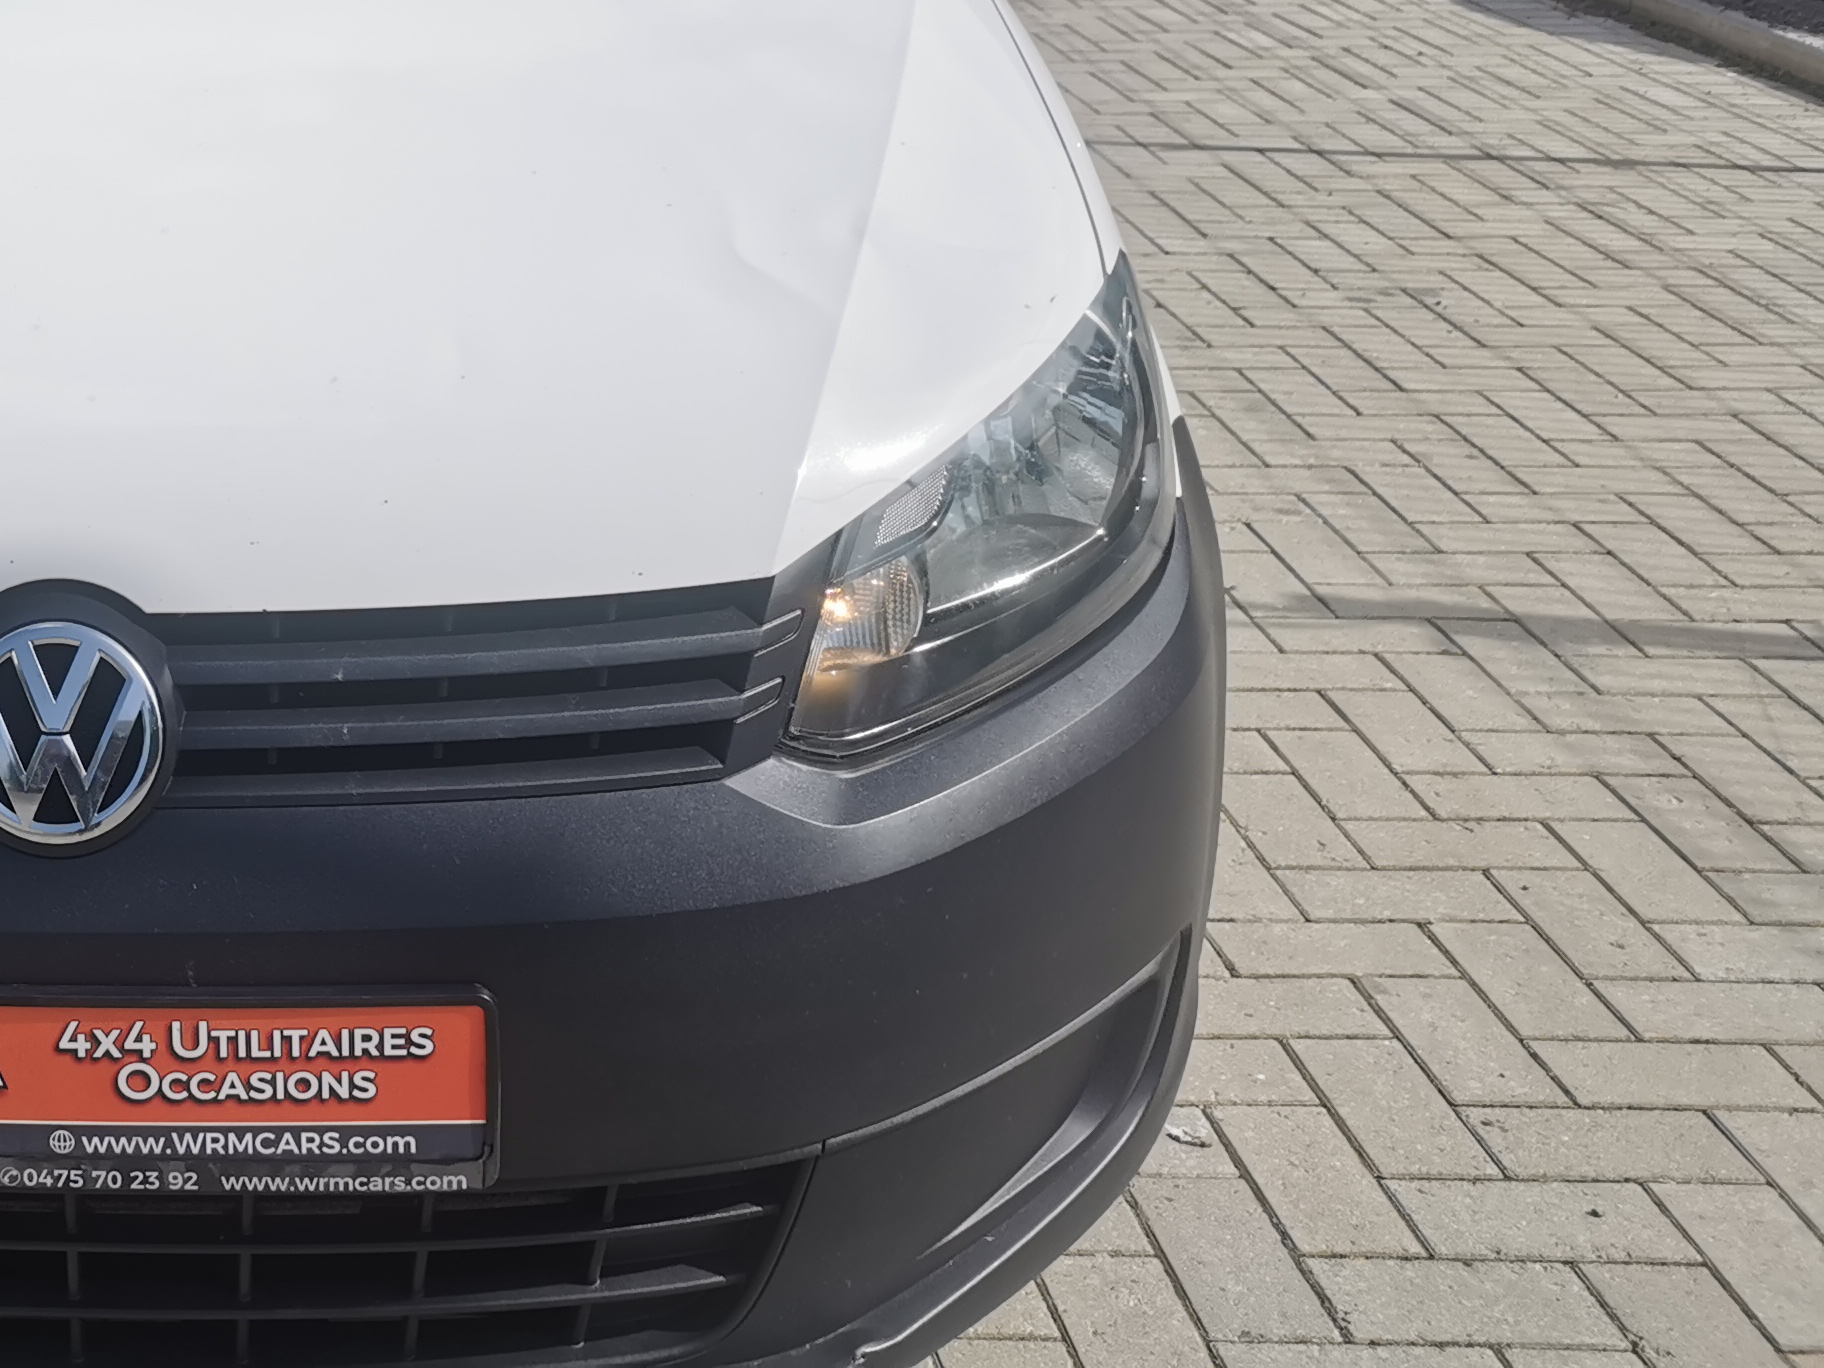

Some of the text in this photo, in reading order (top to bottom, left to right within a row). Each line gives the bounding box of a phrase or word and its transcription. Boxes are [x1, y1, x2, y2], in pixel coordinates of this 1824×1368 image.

[170, 1020, 436, 1059] UTILITAIRES
[116, 1062, 378, 1100] OCCASIONS
[81, 1132, 417, 1155] www.WRMCARS.com
[23, 1168, 84, 1188] 0475
[91, 1169, 122, 1189] 70
[130, 1169, 161, 1189] 23
[168, 1170, 199, 1190] 92
[220, 1173, 467, 1193] www.wrmcars.com
